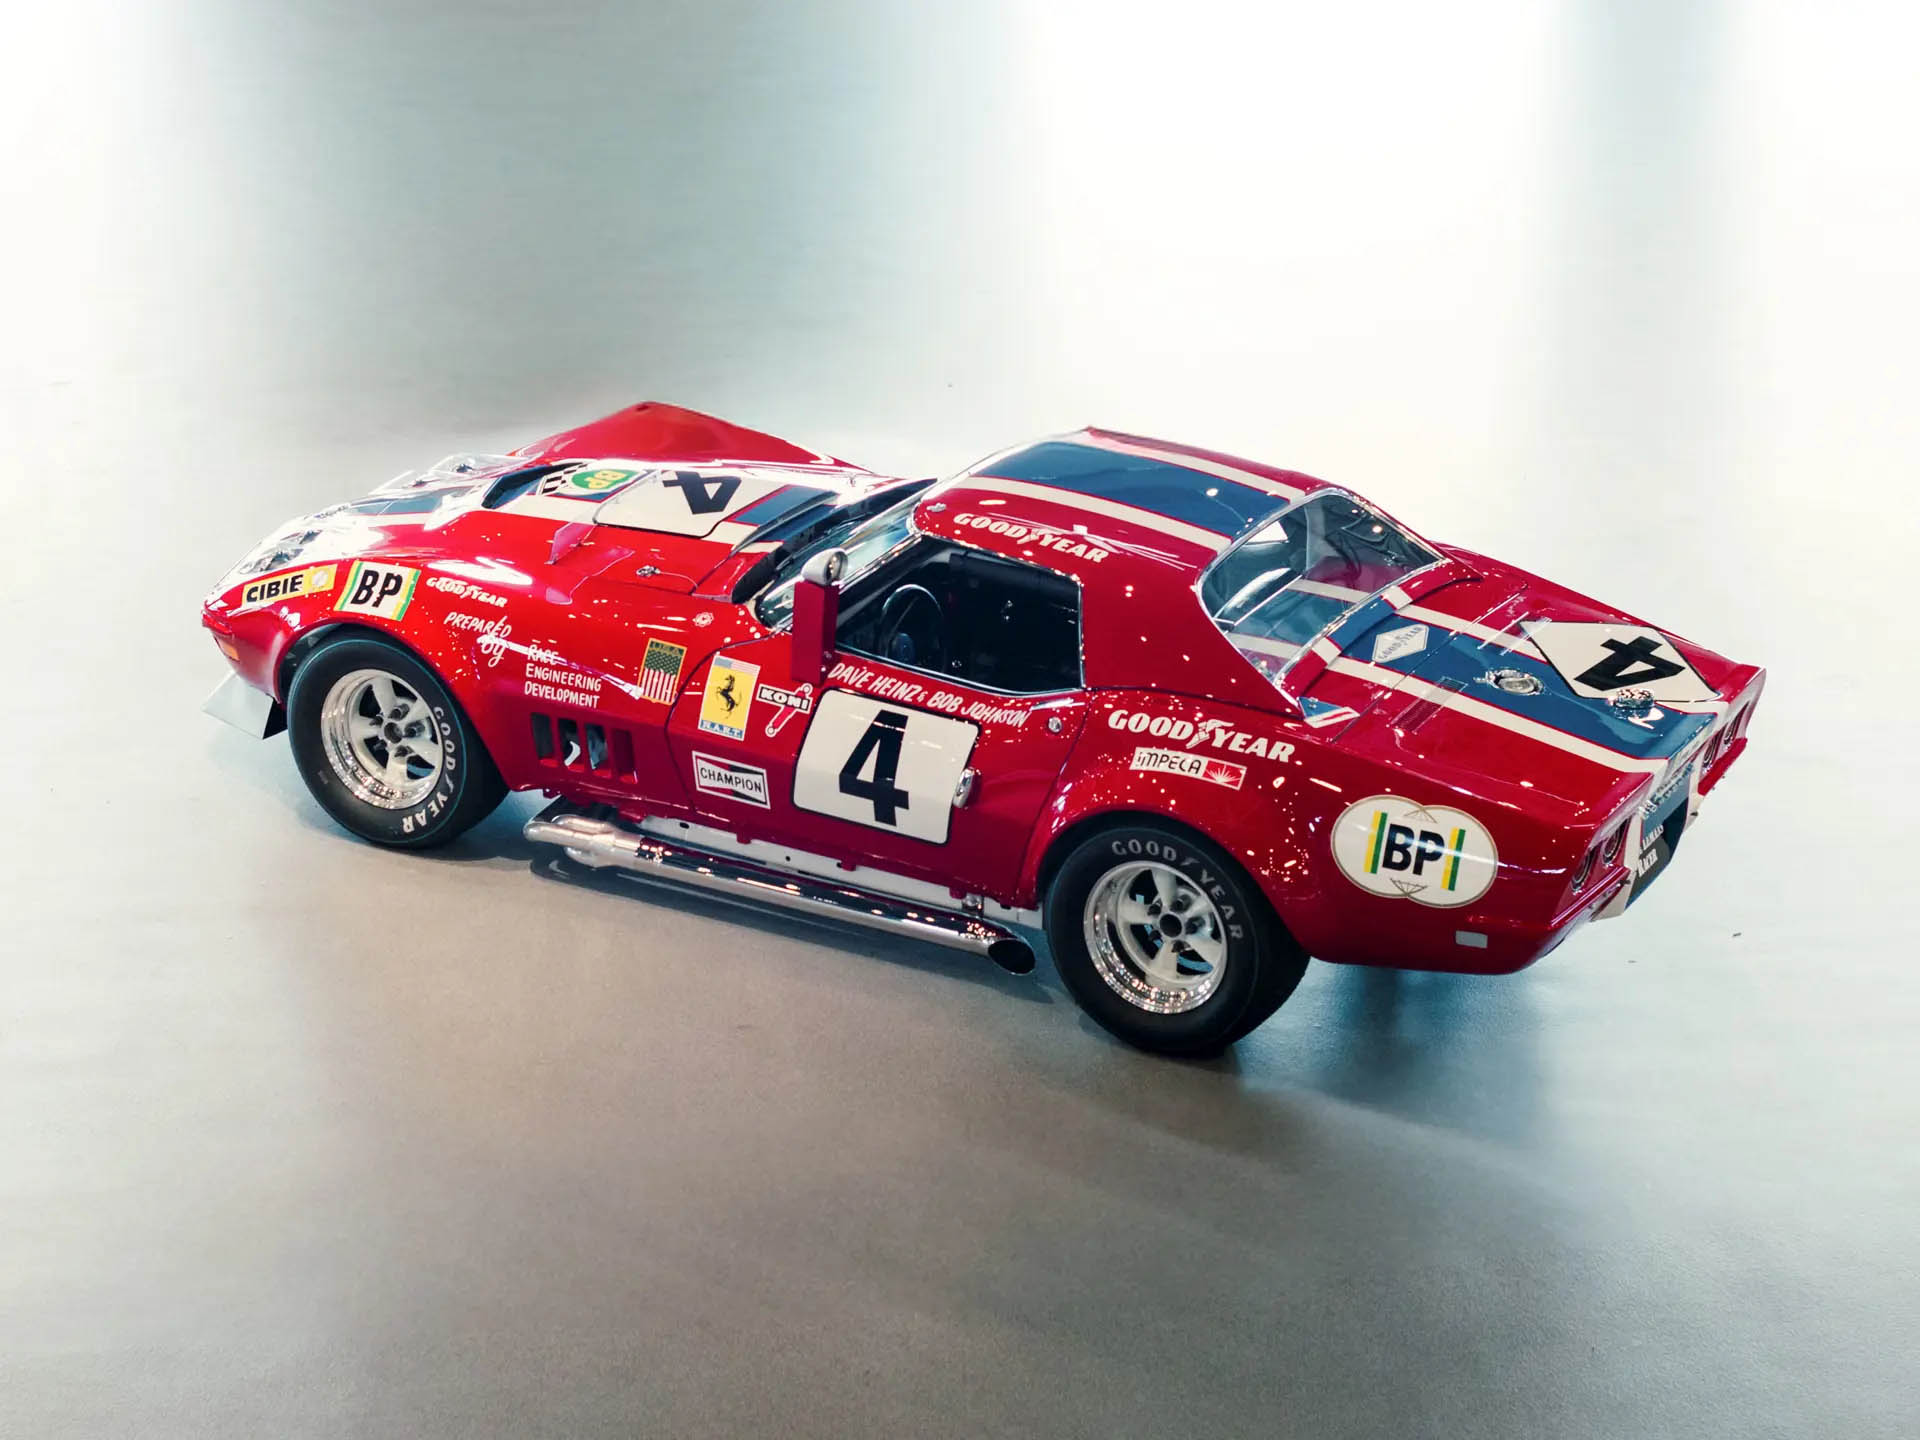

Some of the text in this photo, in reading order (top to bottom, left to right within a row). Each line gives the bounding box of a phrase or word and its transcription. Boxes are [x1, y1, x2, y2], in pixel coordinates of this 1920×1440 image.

[662, 471, 741, 515] 4
[246, 574, 304, 602] CIBIE
[350, 569, 403, 608] BP
[443, 611, 512, 638] PREPARED
[527, 644, 559, 665] RACE
[1574, 635, 1686, 691] 4
[525, 663, 602, 692] ENGINEERING
[524, 681, 600, 708] DEVELOPMENT
[760, 688, 809, 711] KONI
[827, 662, 874, 688] DAVE
[868, 675, 920, 702] HEINZ
[927, 691, 963, 713] BOB
[961, 701, 1032, 728] JOHNSON
[700, 767, 762, 793] CHAMPION
[839, 710, 909, 827] 4
[1382, 824, 1445, 876] BP
